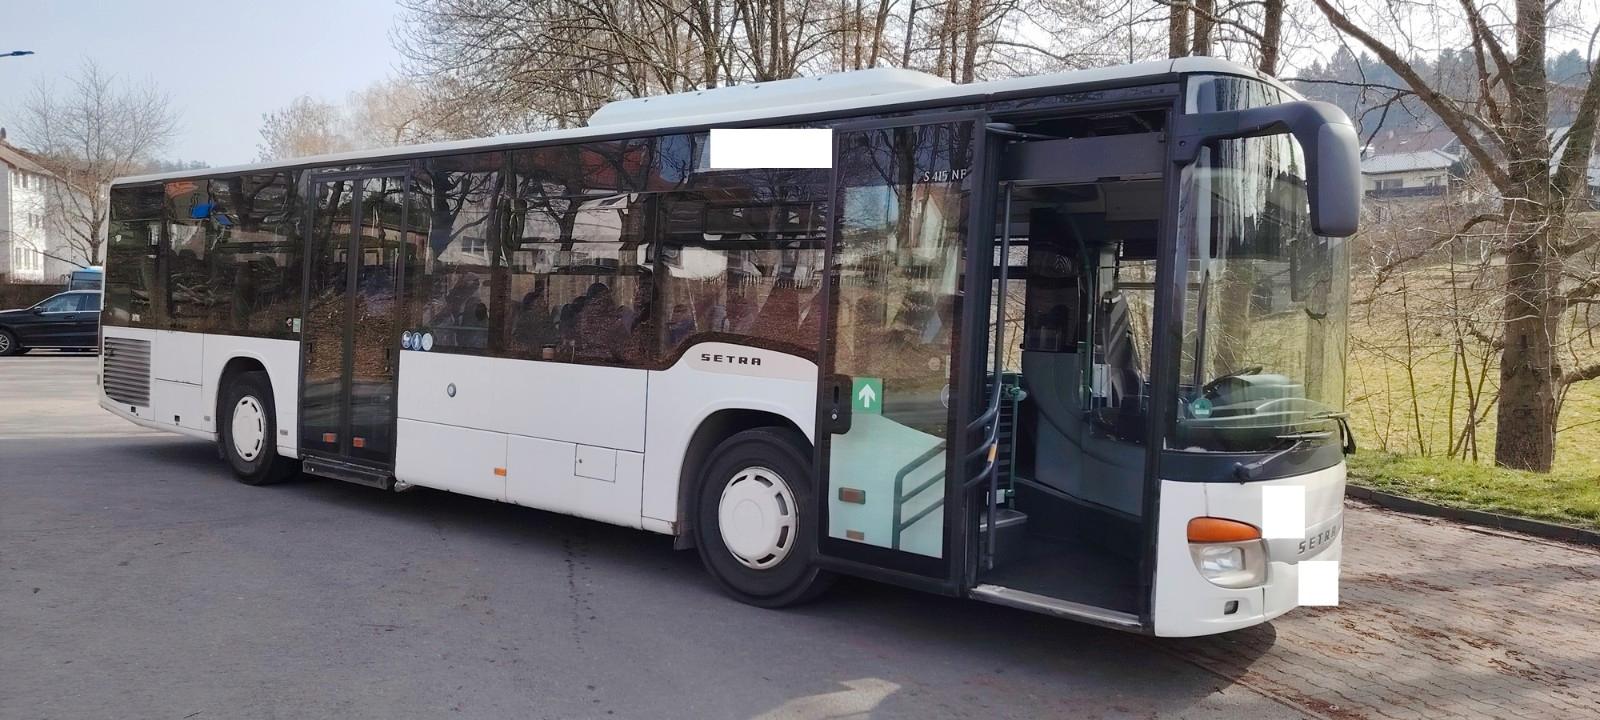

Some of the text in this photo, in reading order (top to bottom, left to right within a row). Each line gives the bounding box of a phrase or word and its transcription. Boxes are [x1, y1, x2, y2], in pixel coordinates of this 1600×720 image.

[923, 170, 931, 182] S
[932, 169, 949, 182] 415
[700, 353, 762, 366] SETRA
[1297, 525, 1337, 555] SETRA
